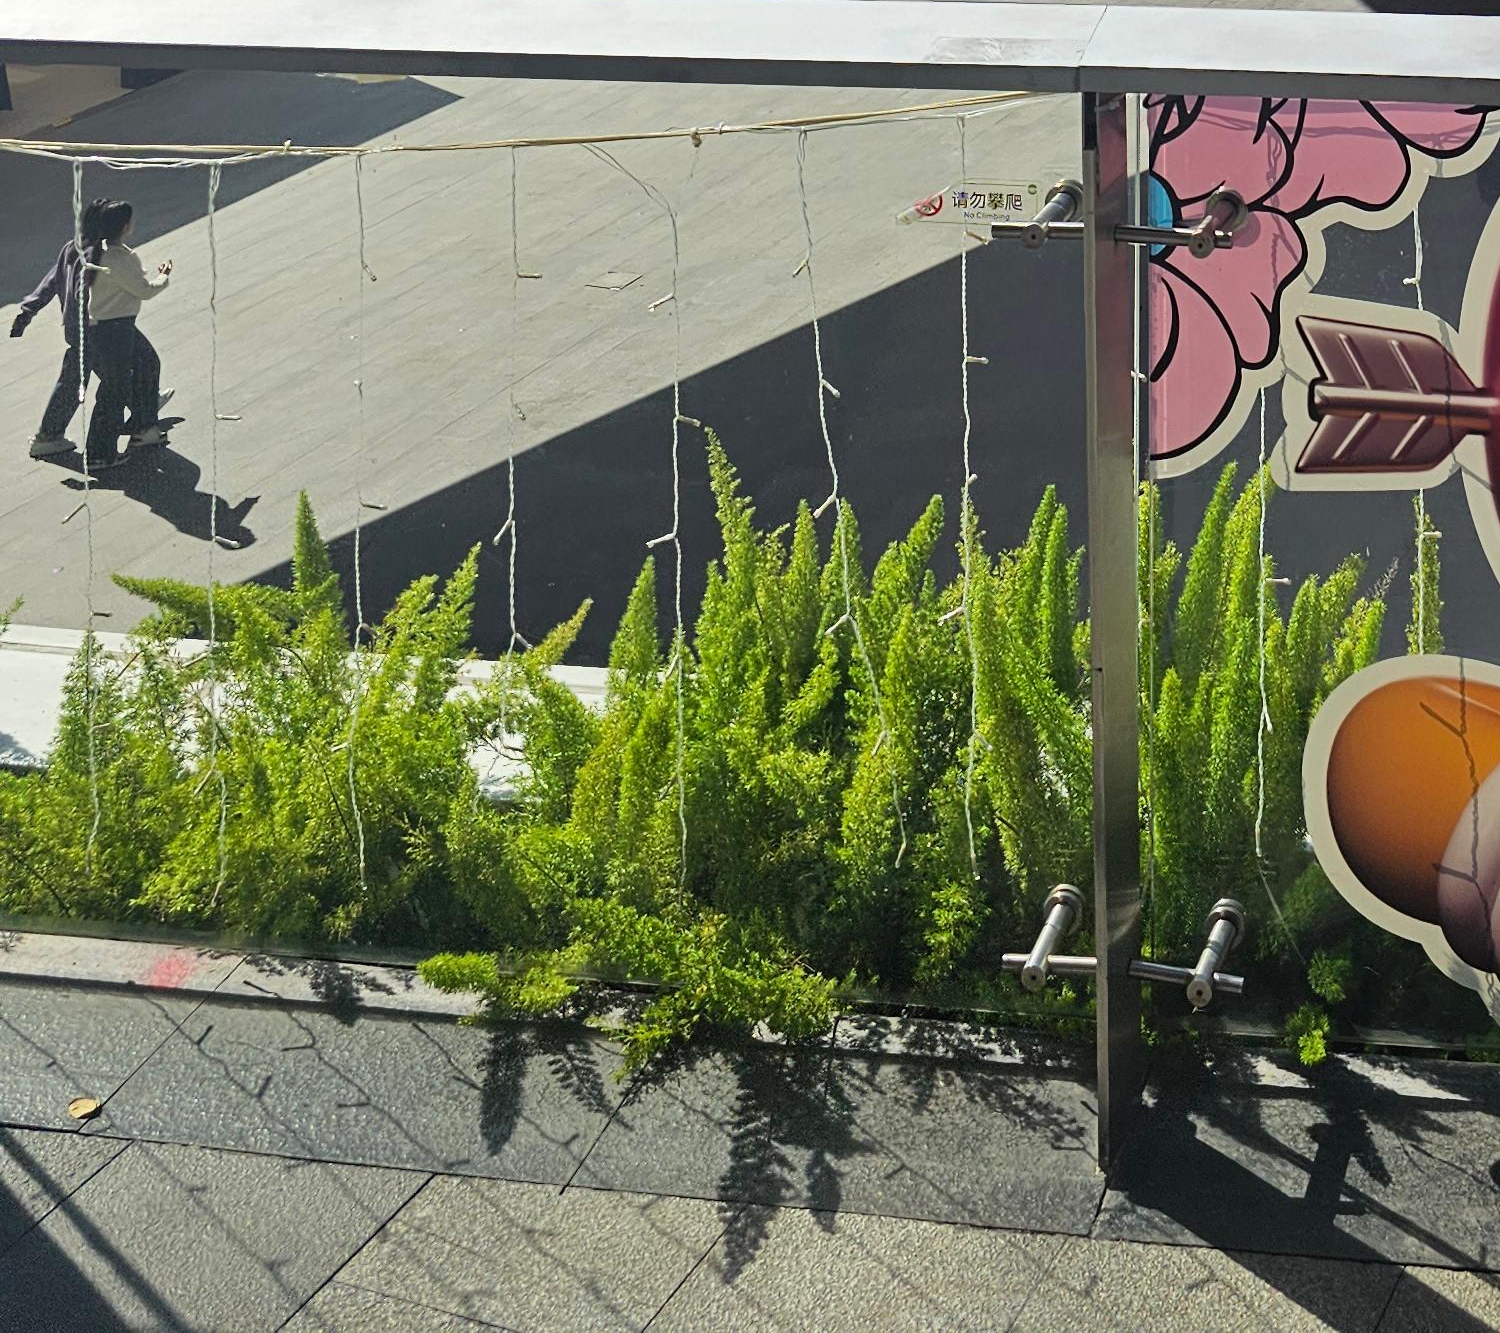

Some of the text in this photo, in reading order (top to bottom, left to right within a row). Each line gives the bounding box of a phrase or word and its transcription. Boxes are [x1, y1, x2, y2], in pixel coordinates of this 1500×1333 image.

[951, 191, 1023, 212] 请勿攀爬
[964, 211, 1010, 222] No Climbing
